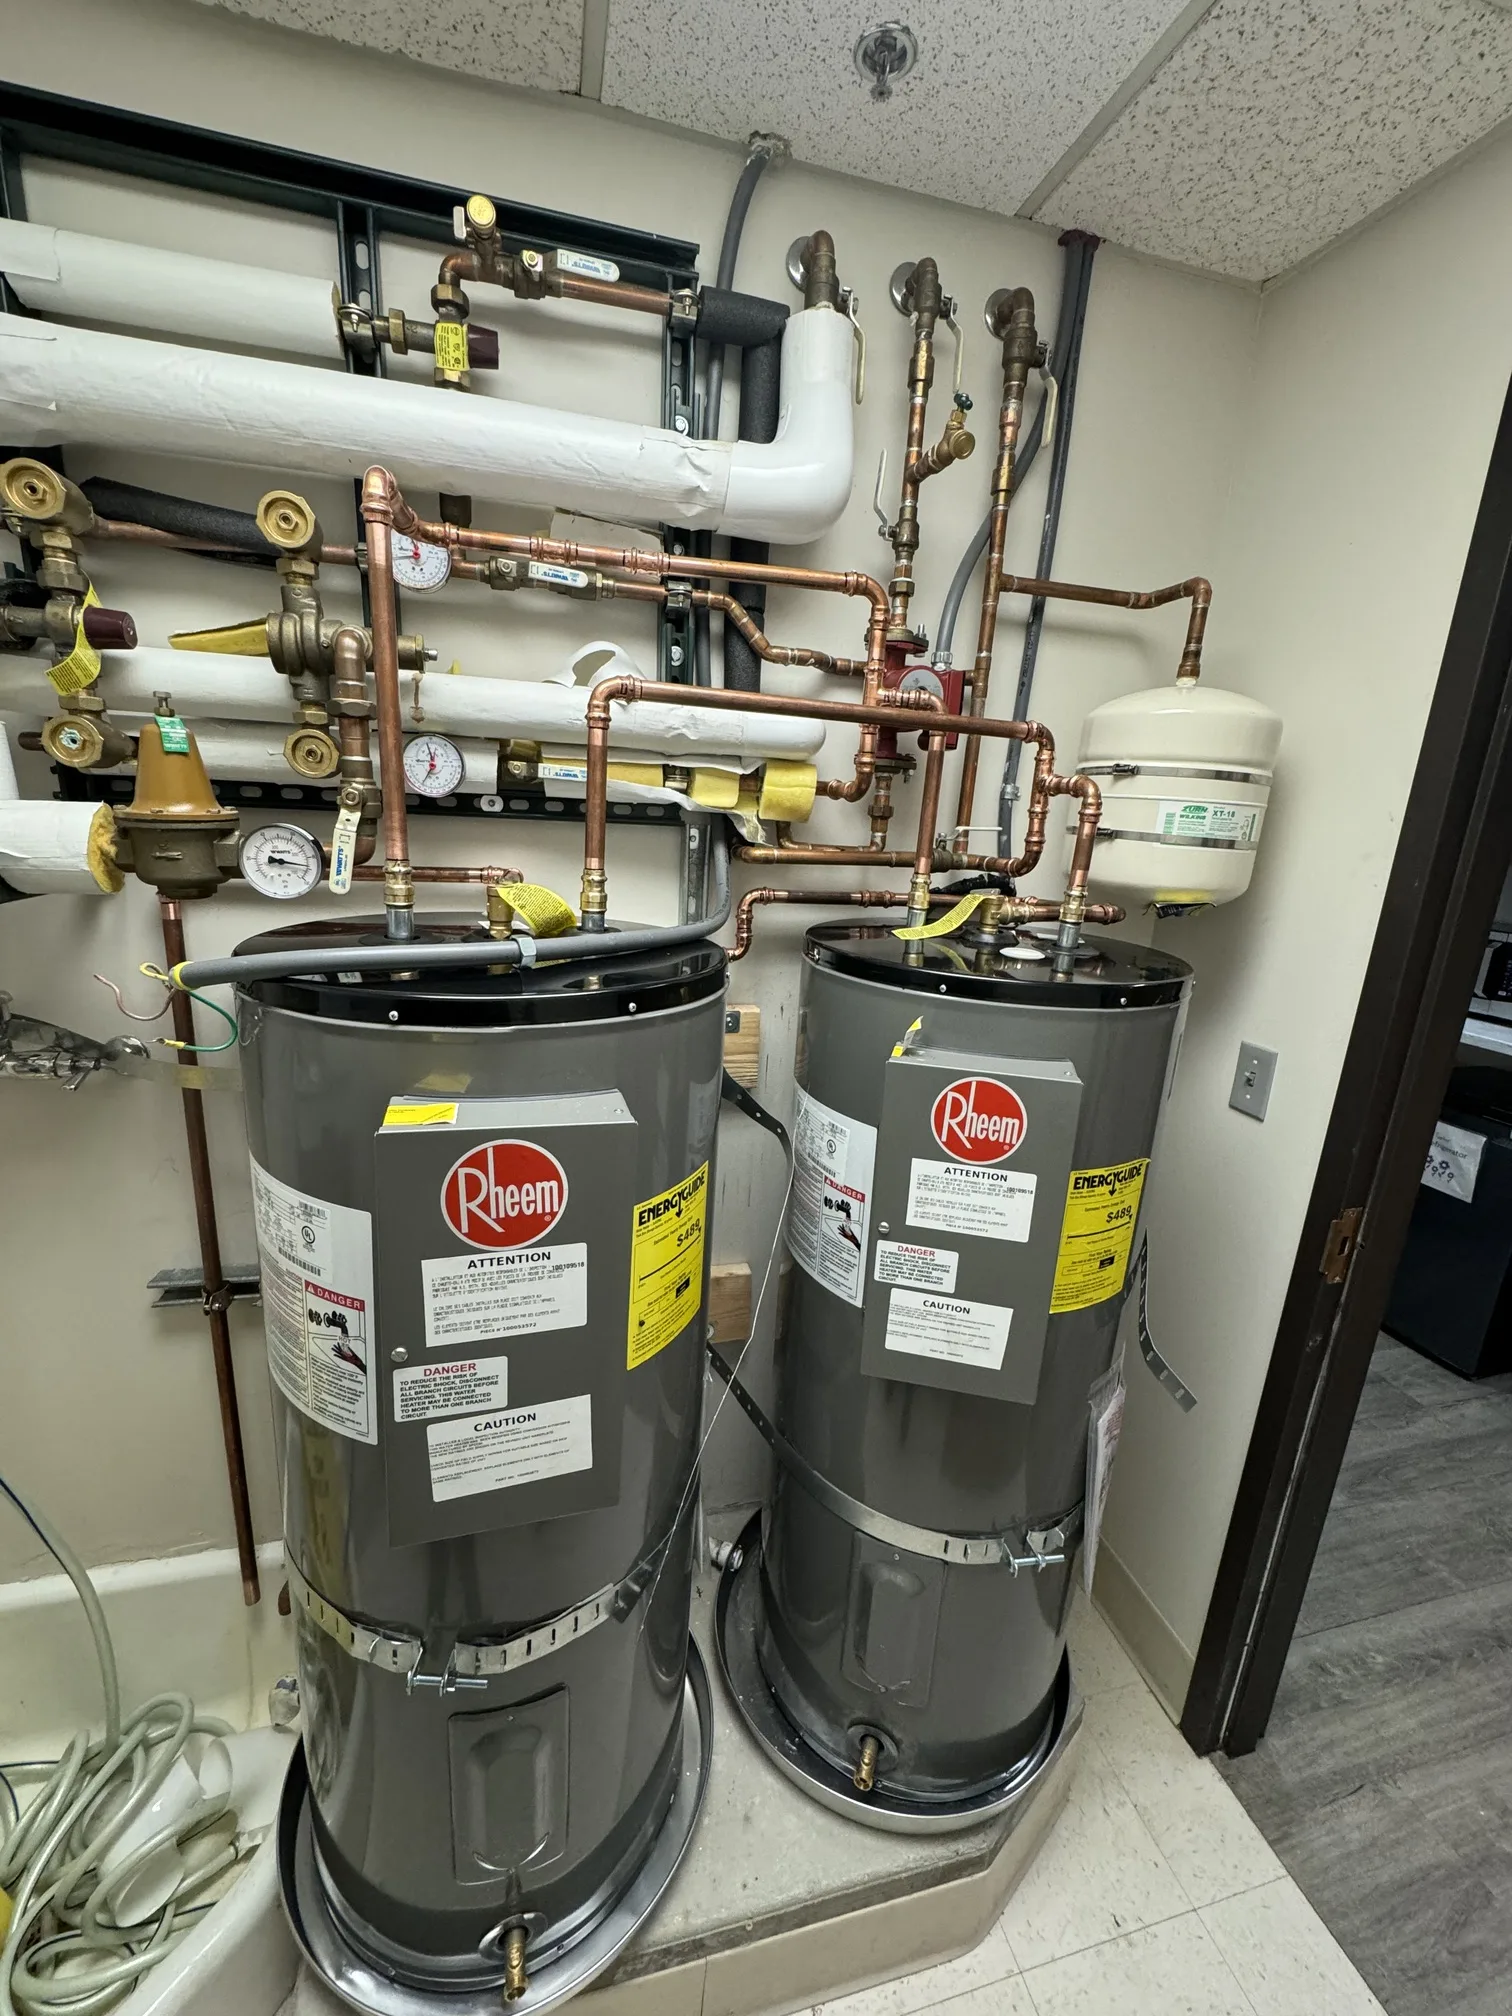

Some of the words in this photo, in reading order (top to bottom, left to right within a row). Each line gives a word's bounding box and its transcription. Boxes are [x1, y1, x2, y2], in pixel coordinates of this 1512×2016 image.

[1212, 810, 1235, 818] XT-18
[941, 1080, 1020, 1149] Rheem
[944, 1167, 1008, 1182] ATTENTION
[1073, 1164, 1143, 1190] ENERGYGUIDE
[458, 1147, 558, 1233] Rheem
[639, 1170, 705, 1226] ENERGYGUIDE
[898, 1245, 935, 1257] DANGER
[468, 1252, 551, 1269] ATTENTION
[552, 1262, 584, 1271] 100109518
[317, 1288, 361, 1310] DANGER
[923, 1300, 970, 1314] CAUTION
[424, 1363, 476, 1377] DANGER
[400, 1384, 432, 1392] ELECTRIC
[434, 1380, 458, 1388] SHOCK,
[459, 1375, 499, 1384] DISCONNECT
[443, 1384, 472, 1392] CIRCUITS
[401, 1395, 436, 1403] SERVICING.
[453, 1392, 491, 1401] CONNECTED
[401, 1412, 427, 1420] CIRCUIT.
[474, 1412, 536, 1432] CAUTION
